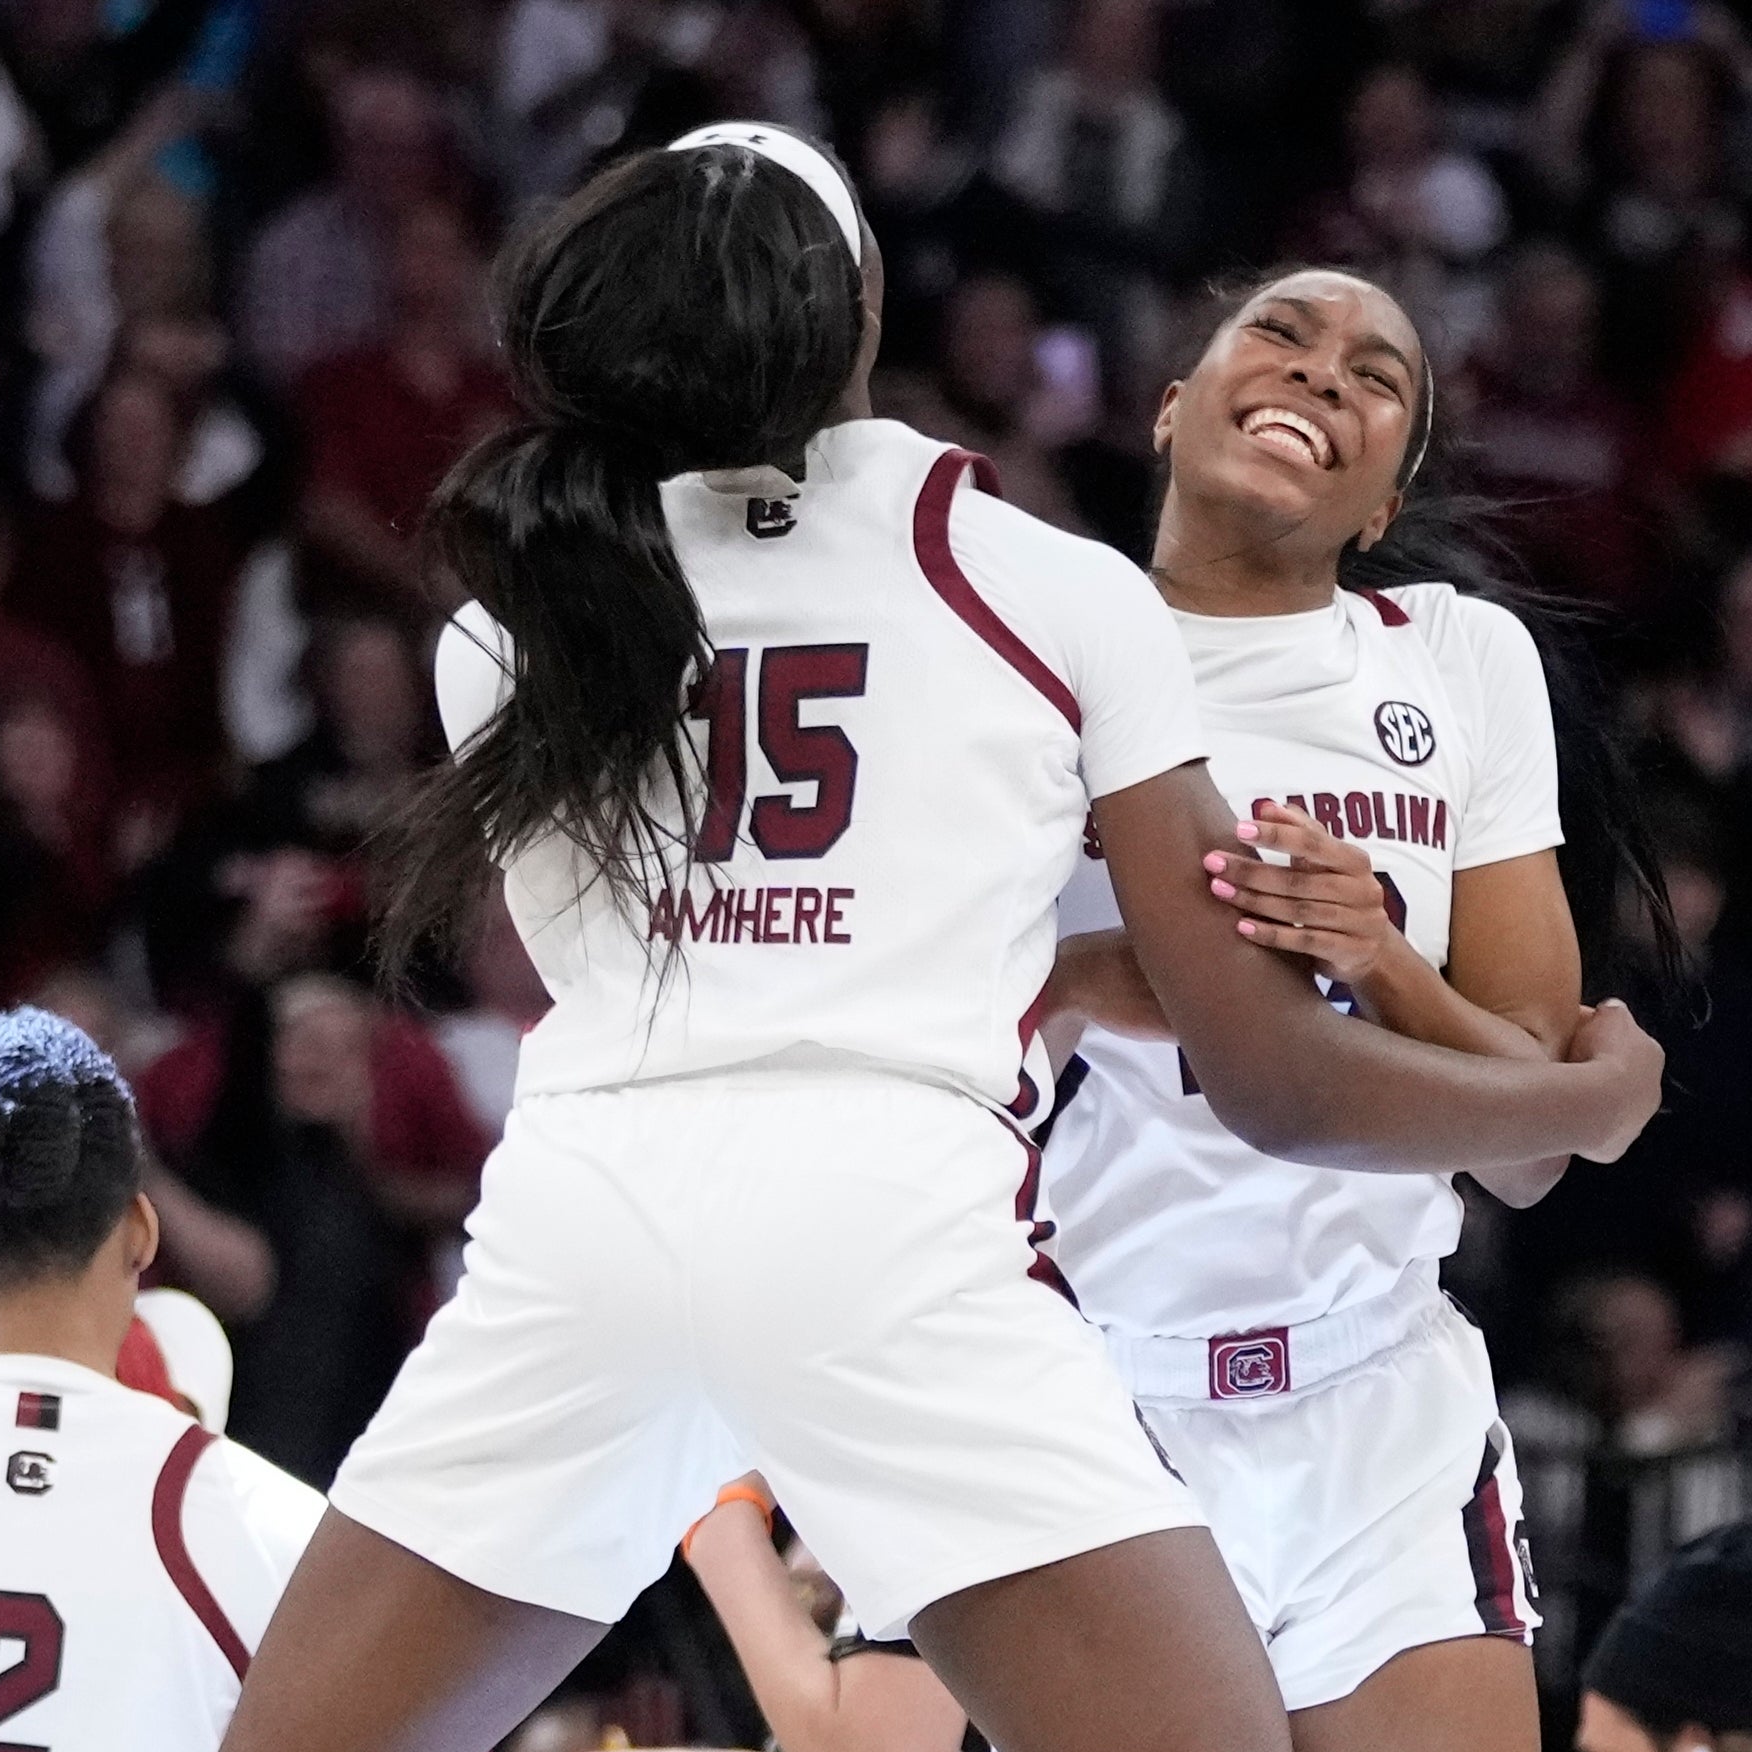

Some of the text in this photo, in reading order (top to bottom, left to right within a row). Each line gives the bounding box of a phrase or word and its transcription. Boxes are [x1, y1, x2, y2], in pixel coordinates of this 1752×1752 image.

[687, 643, 869, 863] 15
[1378, 703, 1433, 763] SEC
[649, 887, 855, 944] AMIHERE
